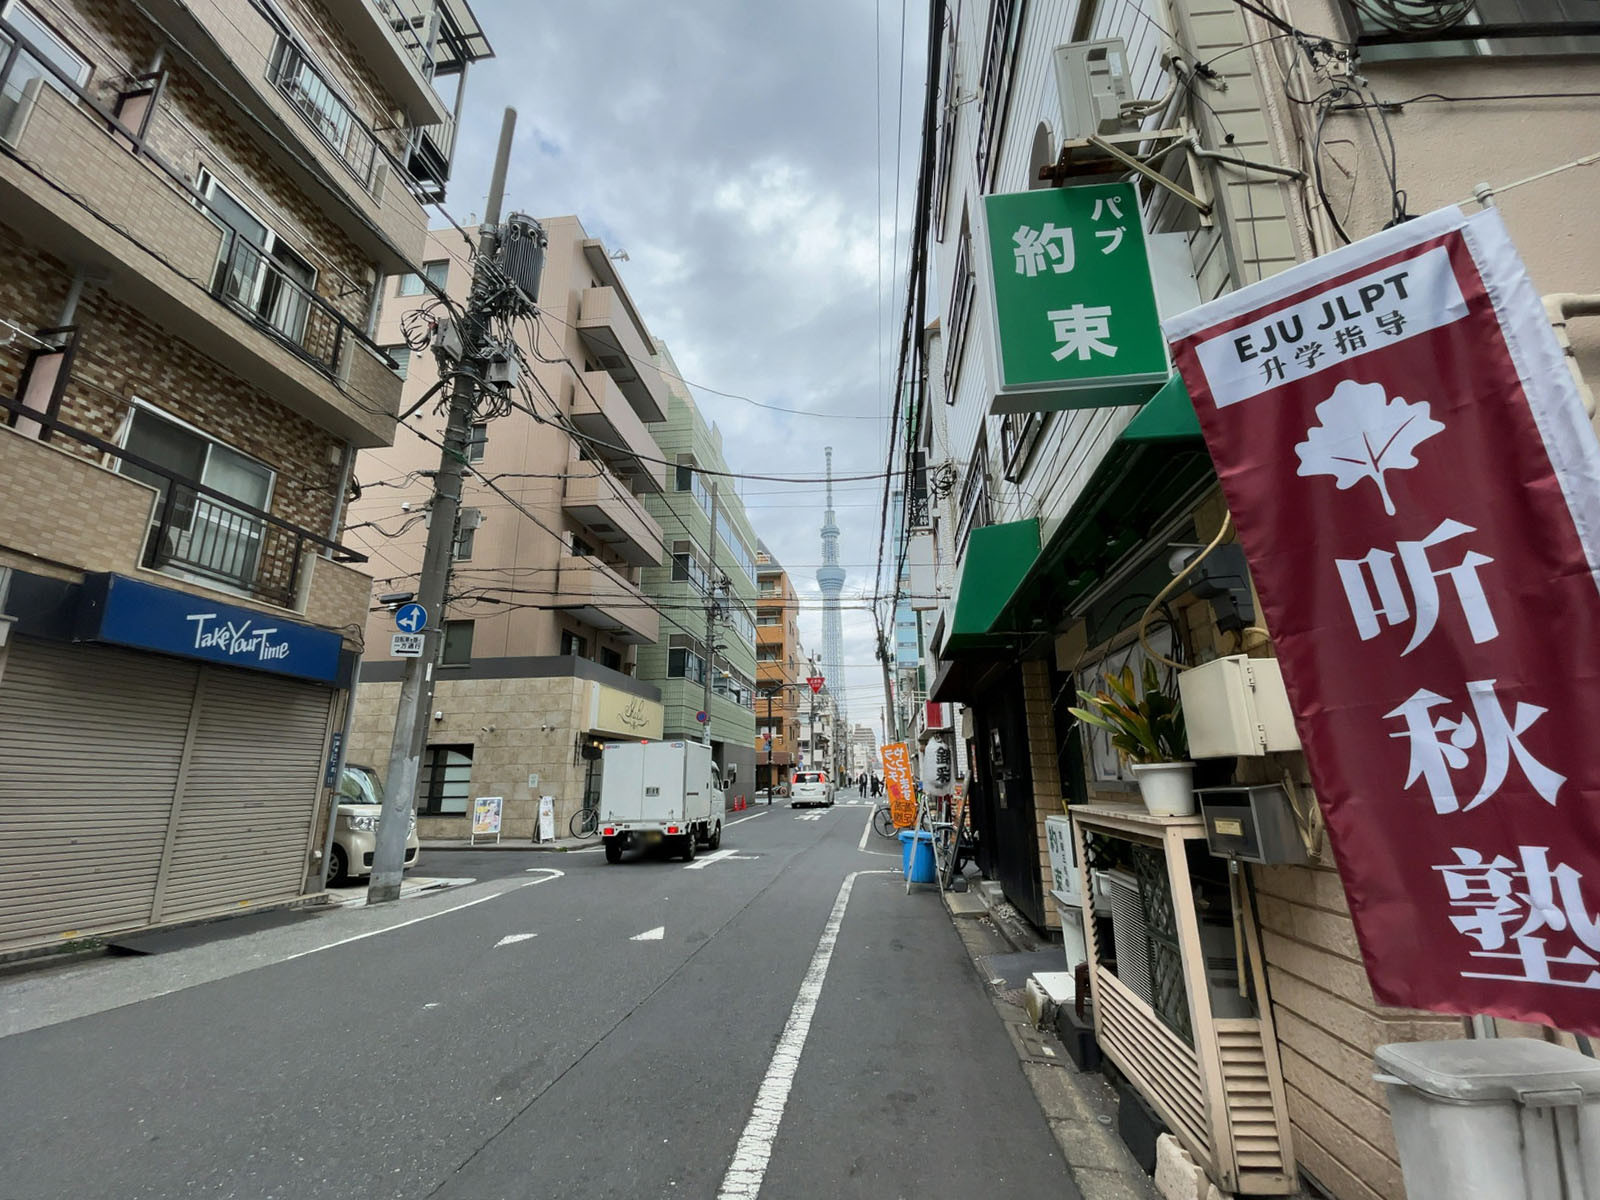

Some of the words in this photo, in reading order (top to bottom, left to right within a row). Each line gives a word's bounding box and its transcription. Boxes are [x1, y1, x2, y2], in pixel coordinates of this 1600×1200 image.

[1091, 196, 1127, 255] パブ
[1012, 223, 1119, 362] 約束
[1233, 314, 1304, 363] EJU
[1317, 271, 1409, 331] JLPT
[1258, 310, 1407, 386] 升学指导
[186, 613, 231, 651] Take
[227, 620, 262, 655] Your
[252, 628, 290, 661] Time
[1335, 517, 1600, 991] 听秋塾
